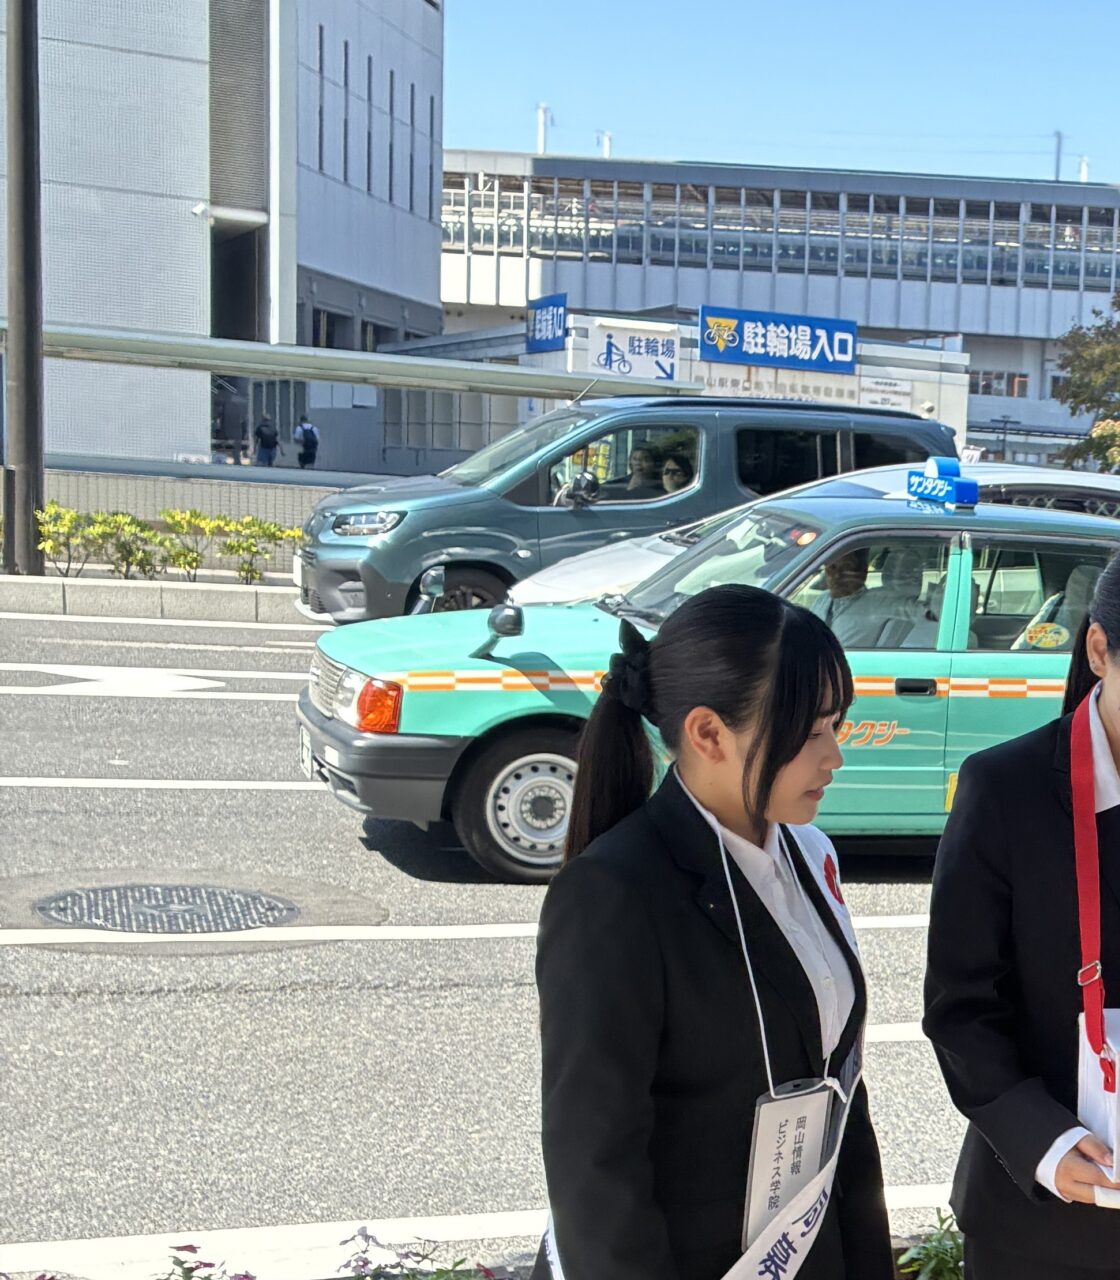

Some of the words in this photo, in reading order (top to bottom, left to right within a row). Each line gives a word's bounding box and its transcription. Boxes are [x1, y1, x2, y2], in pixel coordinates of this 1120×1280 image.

[628, 335, 676, 359] 駐輪場
[741, 320, 854, 363] 駐輪場入口
[910, 475, 953, 497] サンタクシー
[767, 1119, 789, 1211] ビジネス学院
[790, 1115, 807, 1176] 岡山情報
